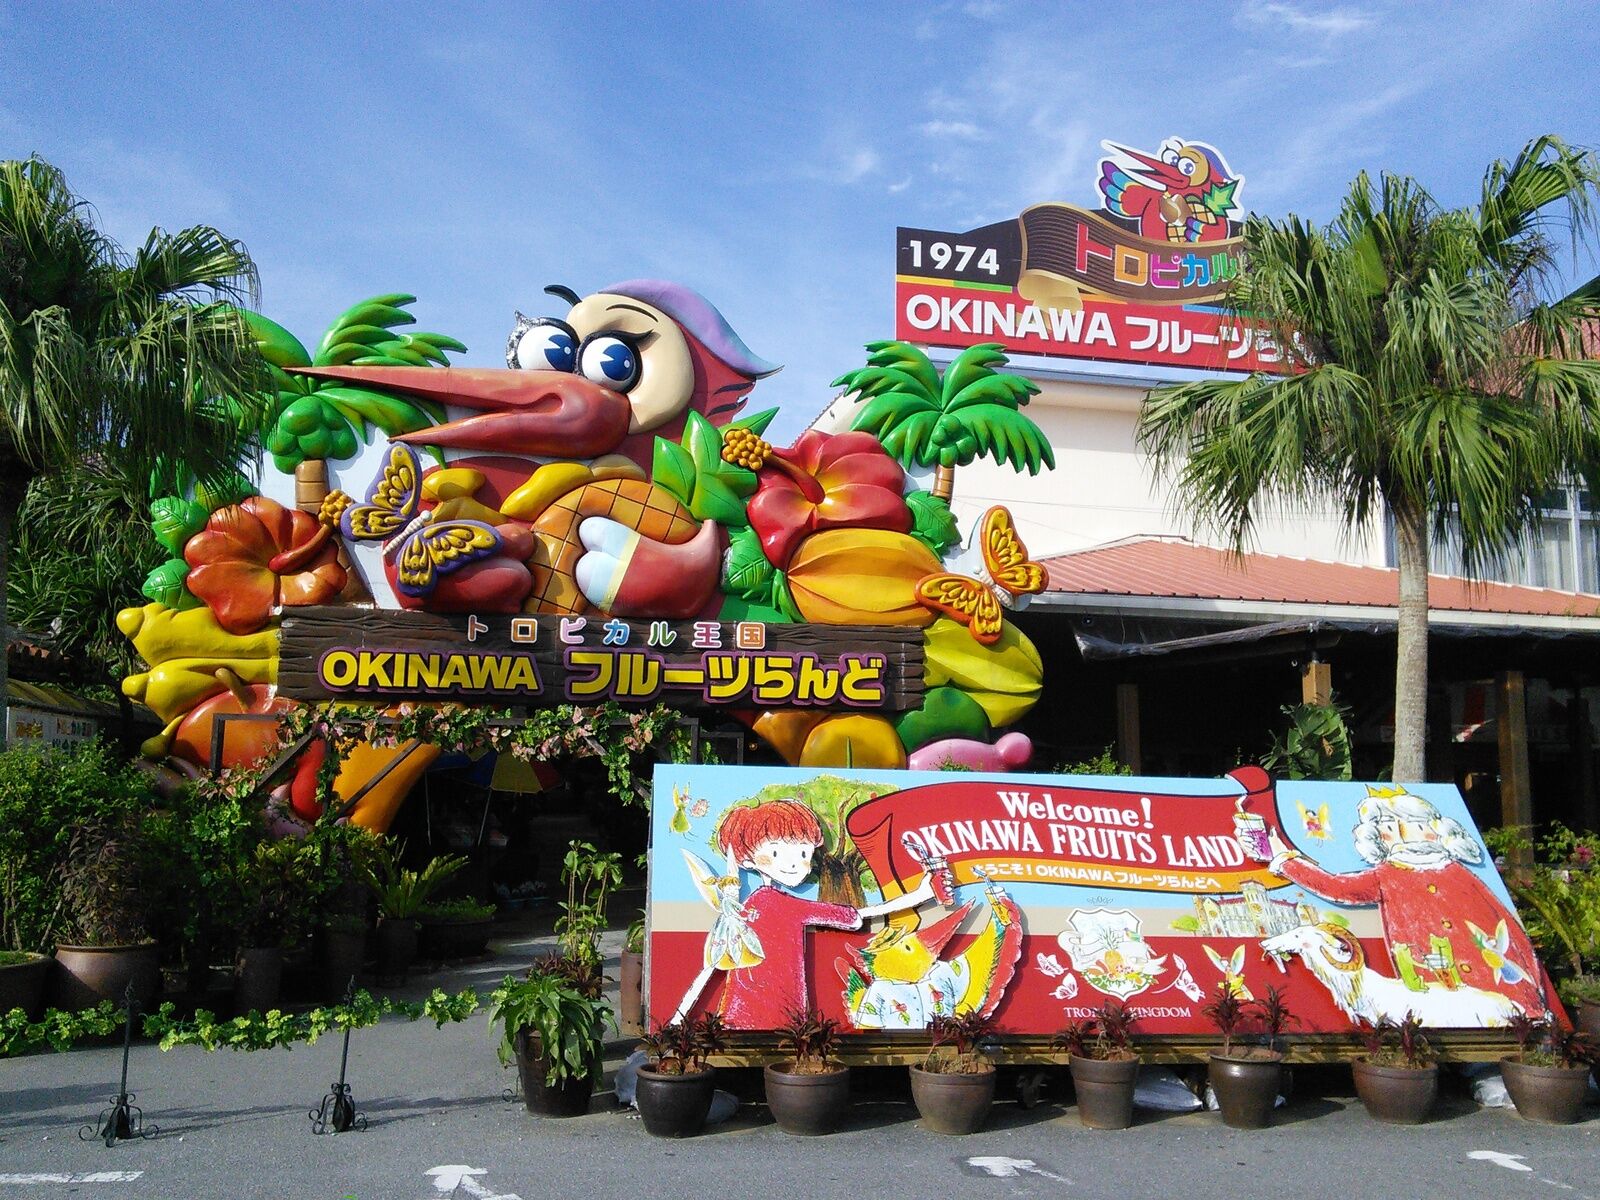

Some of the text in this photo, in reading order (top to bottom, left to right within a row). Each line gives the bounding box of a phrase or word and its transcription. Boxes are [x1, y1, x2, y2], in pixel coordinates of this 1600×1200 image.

[908, 240, 1000, 276] 1974
[1075, 221, 1237, 288] トロピカル
[905, 293, 1118, 347] OKINAWA
[322, 650, 884, 701] OKINAWA フルーツらんど
[996, 790, 1153, 829] Welcome!
[902, 819, 1245, 868] OKINAWA FRUITS LAND
[1128, 1006, 1192, 1019] KINGDOM
